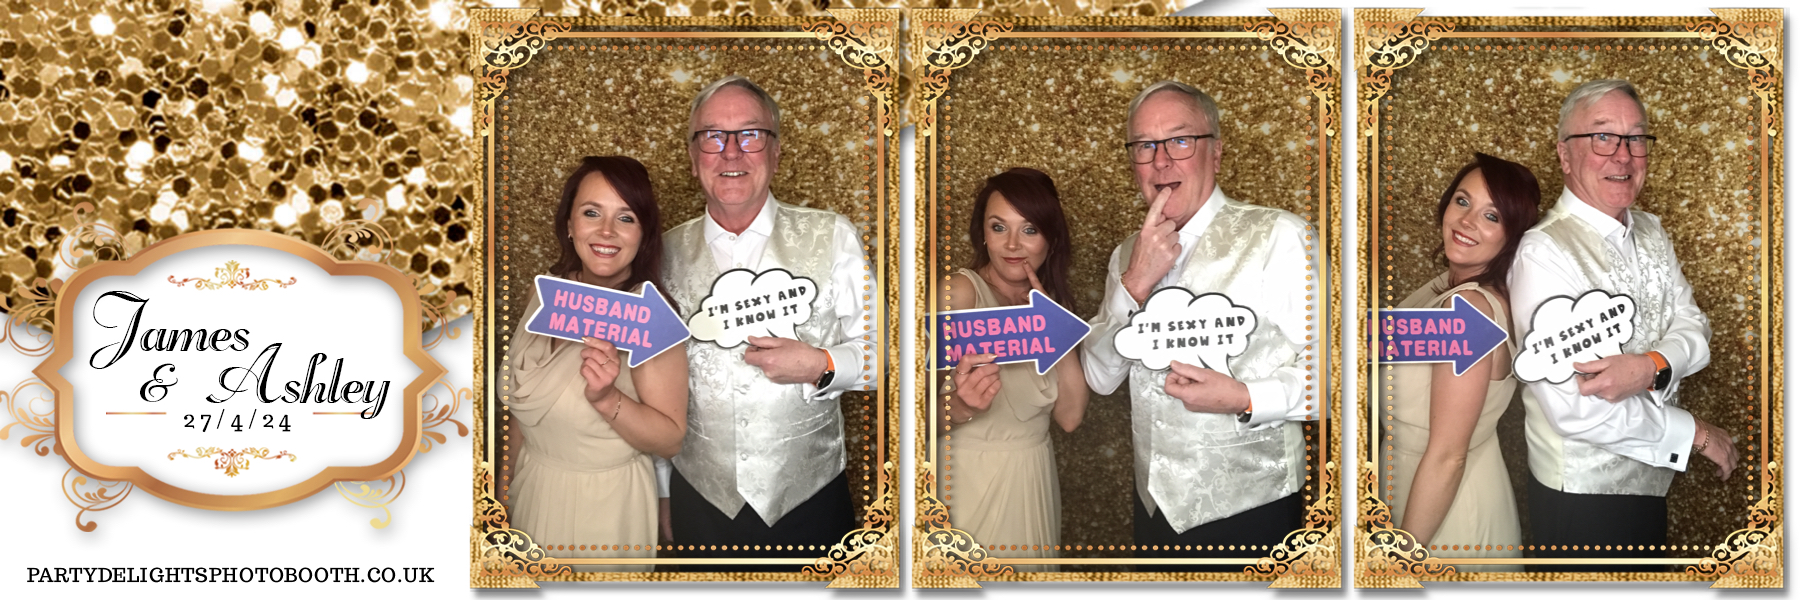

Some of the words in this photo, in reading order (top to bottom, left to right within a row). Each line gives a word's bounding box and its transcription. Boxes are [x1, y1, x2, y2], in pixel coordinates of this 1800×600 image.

[553, 289, 651, 324] HUSBAND
[707, 302, 730, 318] I'M
[735, 294, 771, 311] SEXY
[777, 285, 807, 301] AND
[549, 312, 653, 348] MATERIAL
[722, 319, 731, 330] I
[736, 310, 776, 326] KNOW
[783, 304, 799, 317] IT
[942, 314, 1047, 339] HUSBAND
[1138, 322, 1161, 335] I'M
[1168, 319, 1208, 331] SEXY
[1214, 315, 1247, 328] AND
[1531, 335, 1554, 355] I'M
[1559, 318, 1596, 342] SEXY
[1600, 303, 1626, 323] AND
[945, 336, 1056, 362] MATERIAL
[1152, 339, 1159, 350] I
[1166, 335, 1210, 349] KNOW
[1217, 333, 1234, 346] IT
[1550, 352, 1559, 365] I
[1562, 334, 1602, 359] KNOW
[1606, 322, 1623, 338] IT
